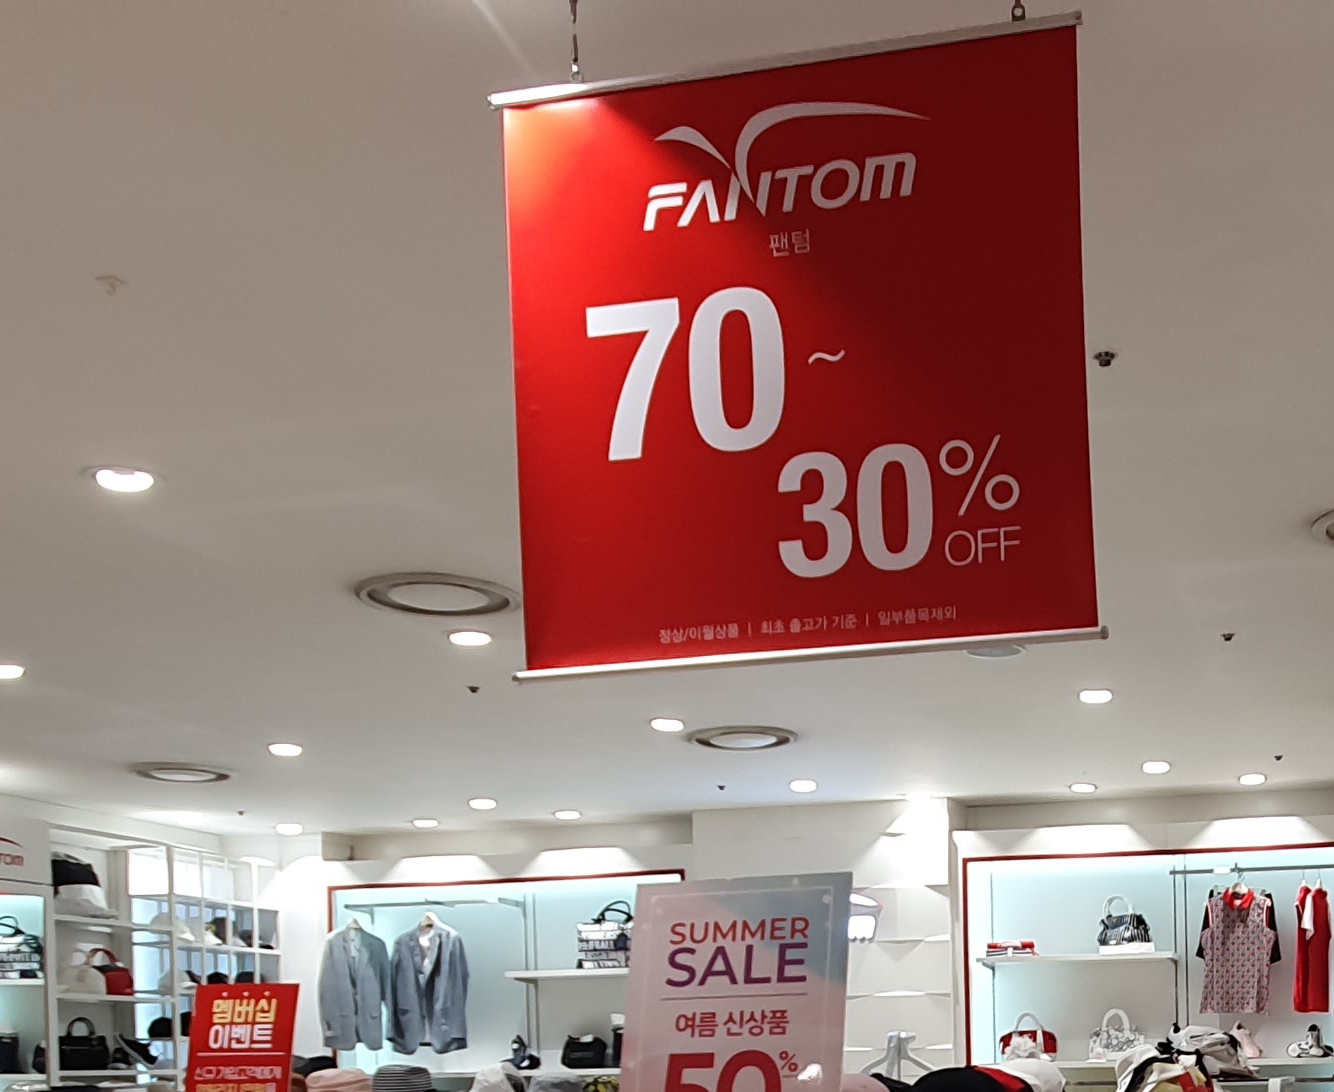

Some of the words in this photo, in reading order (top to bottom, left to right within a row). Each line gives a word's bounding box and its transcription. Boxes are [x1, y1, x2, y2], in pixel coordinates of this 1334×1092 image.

[643, 102, 931, 231] FANTOM
[769, 228, 811, 257] 팬텀
[944, 526, 1021, 566] OFF
[669, 916, 810, 946] SUMMER
[665, 942, 809, 987] SALE
[211, 998, 278, 1024] 멤버십
[675, 1011, 719, 1038] 여름
[723, 1009, 790, 1037] 신상품
[208, 1024, 275, 1050] 이벤트
